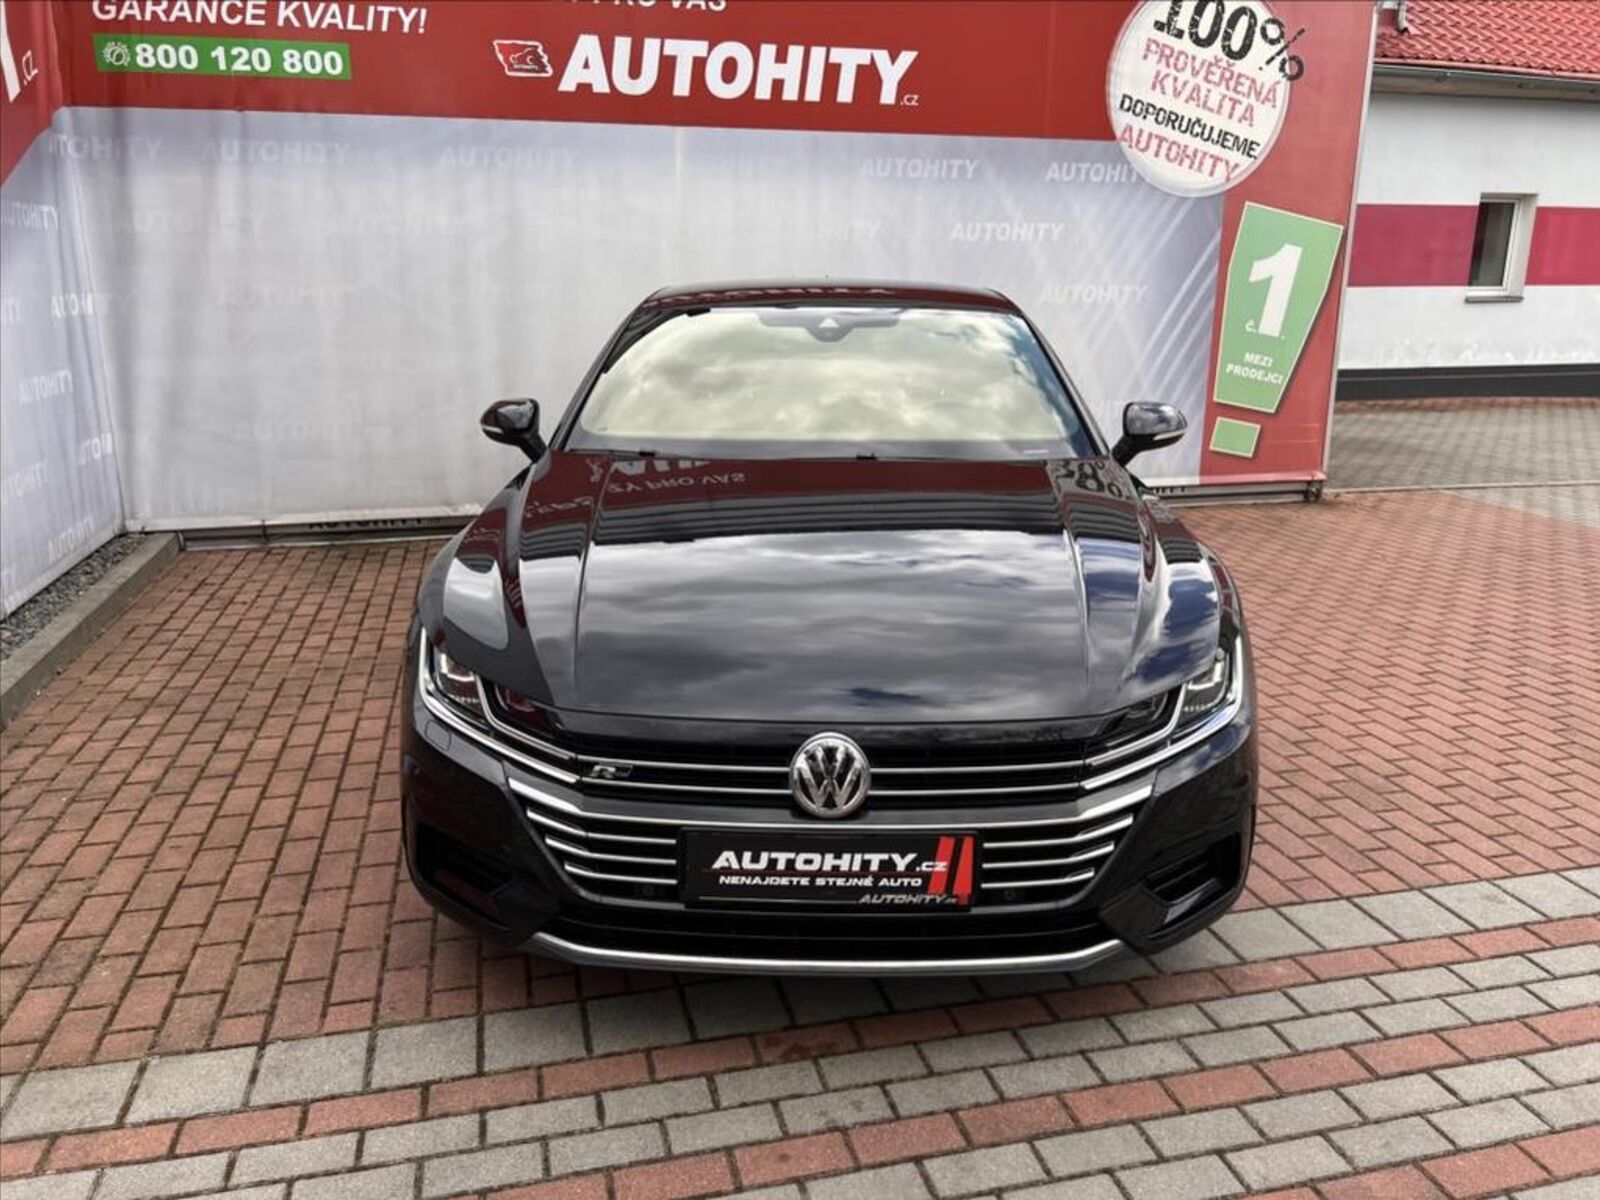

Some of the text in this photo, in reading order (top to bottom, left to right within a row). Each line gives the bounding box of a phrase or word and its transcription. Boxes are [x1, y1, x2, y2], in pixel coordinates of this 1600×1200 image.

[92, 0, 427, 33] GARANCE KVALITY!
[1153, 0, 1305, 81] 100%
[134, 42, 344, 75] 800 120 800
[1142, 38, 1282, 109] PROVĚŘENÁ
[1150, 69, 1255, 128] KVALITA
[1118, 94, 1261, 159] DOPORUČUJEME
[860, 157, 982, 180] AUTOHITY
[1117, 124, 1241, 184] AUTOHITY
[1045, 162, 1140, 183] AUTOHIT
[949, 222, 1065, 244] AUTOHITY
[1225, 363, 1284, 385] PRODEJCI
[1243, 352, 1274, 367] MEZI
[719, 874, 922, 888] NENAJDETE STEJNÉ AUTO
